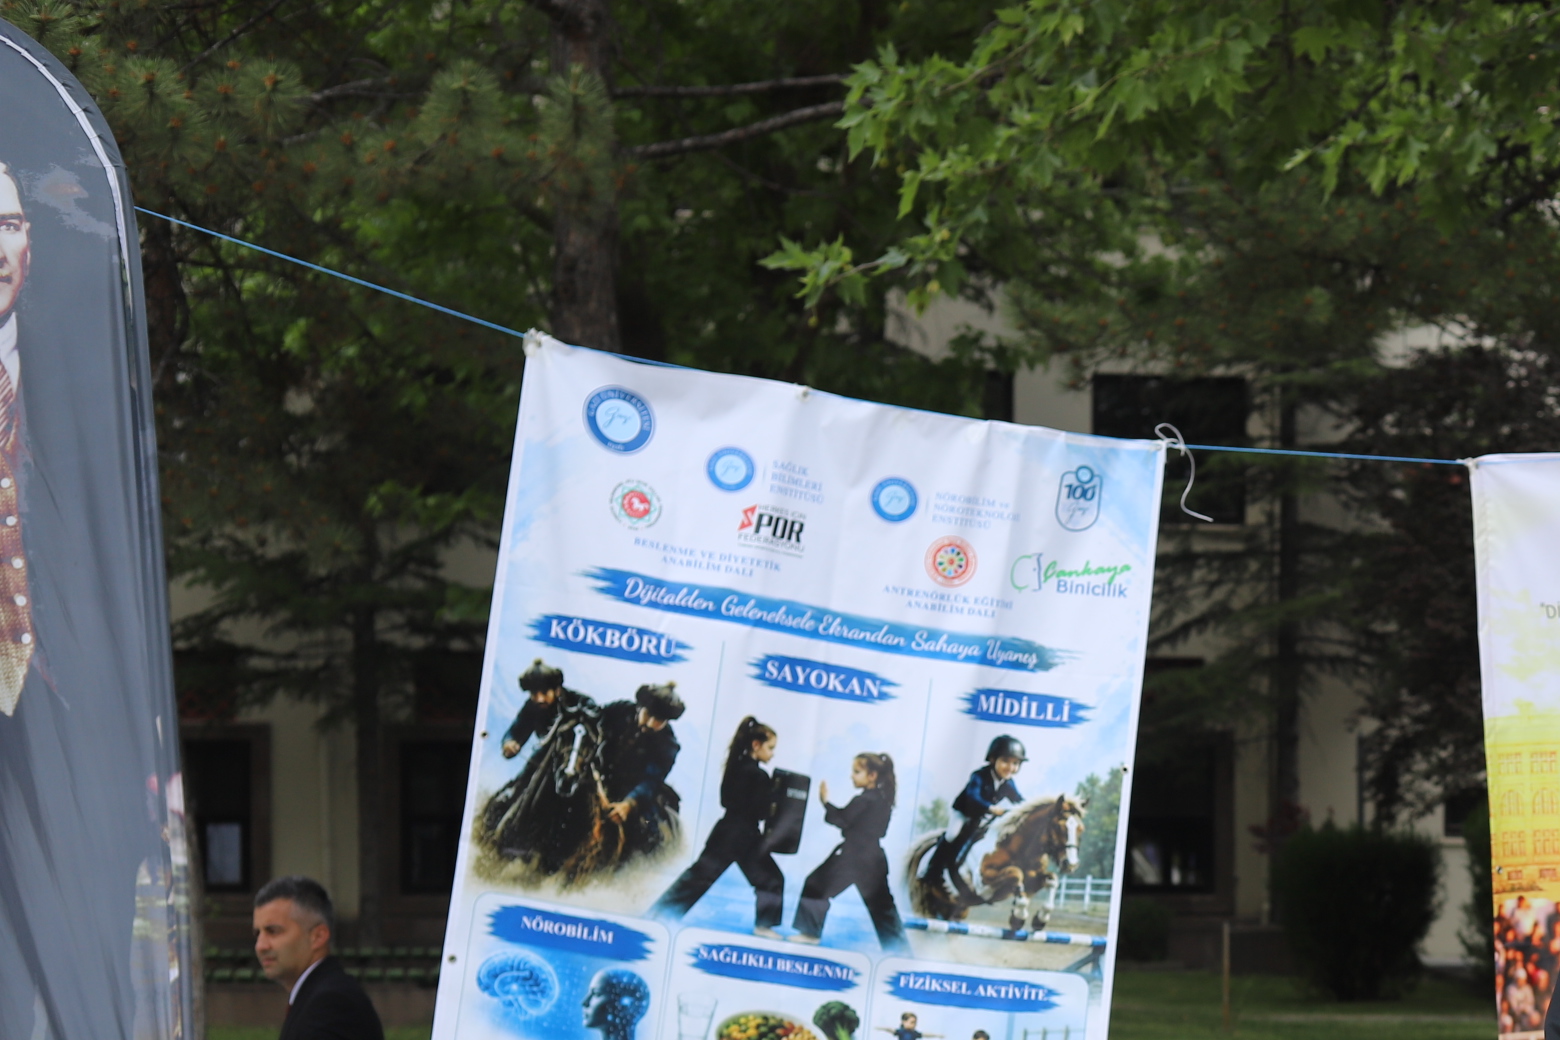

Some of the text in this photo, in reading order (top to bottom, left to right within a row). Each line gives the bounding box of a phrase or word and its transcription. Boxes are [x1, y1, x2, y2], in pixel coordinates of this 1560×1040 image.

[772, 459, 810, 476] SAĞLIK
[1064, 484, 1098, 502] 100
[737, 503, 805, 544] SPOR
[633, 537, 698, 558] BESLENME
[700, 549, 716, 561] VE
[718, 551, 782, 572] DİYETETİK
[660, 555, 755, 577] ANABİLİM DALI
[1055, 579, 1128, 599] Binicilik
[624, 577, 1039, 669] Dijitalden Geleneksele Ekrandan Sahaya Uyanış
[905, 599, 997, 619] ANABİLİM DALI
[550, 617, 677, 658] KÖKBÖRÜ
[765, 658, 882, 699] SAYOKAN
[977, 692, 1071, 723] MİDİLLİ
[520, 914, 615, 944] NÖROBİLİM
[699, 946, 775, 969] SAĞLIKLI
[899, 973, 1049, 1003] FİZİKSEL AKTİVİTE
